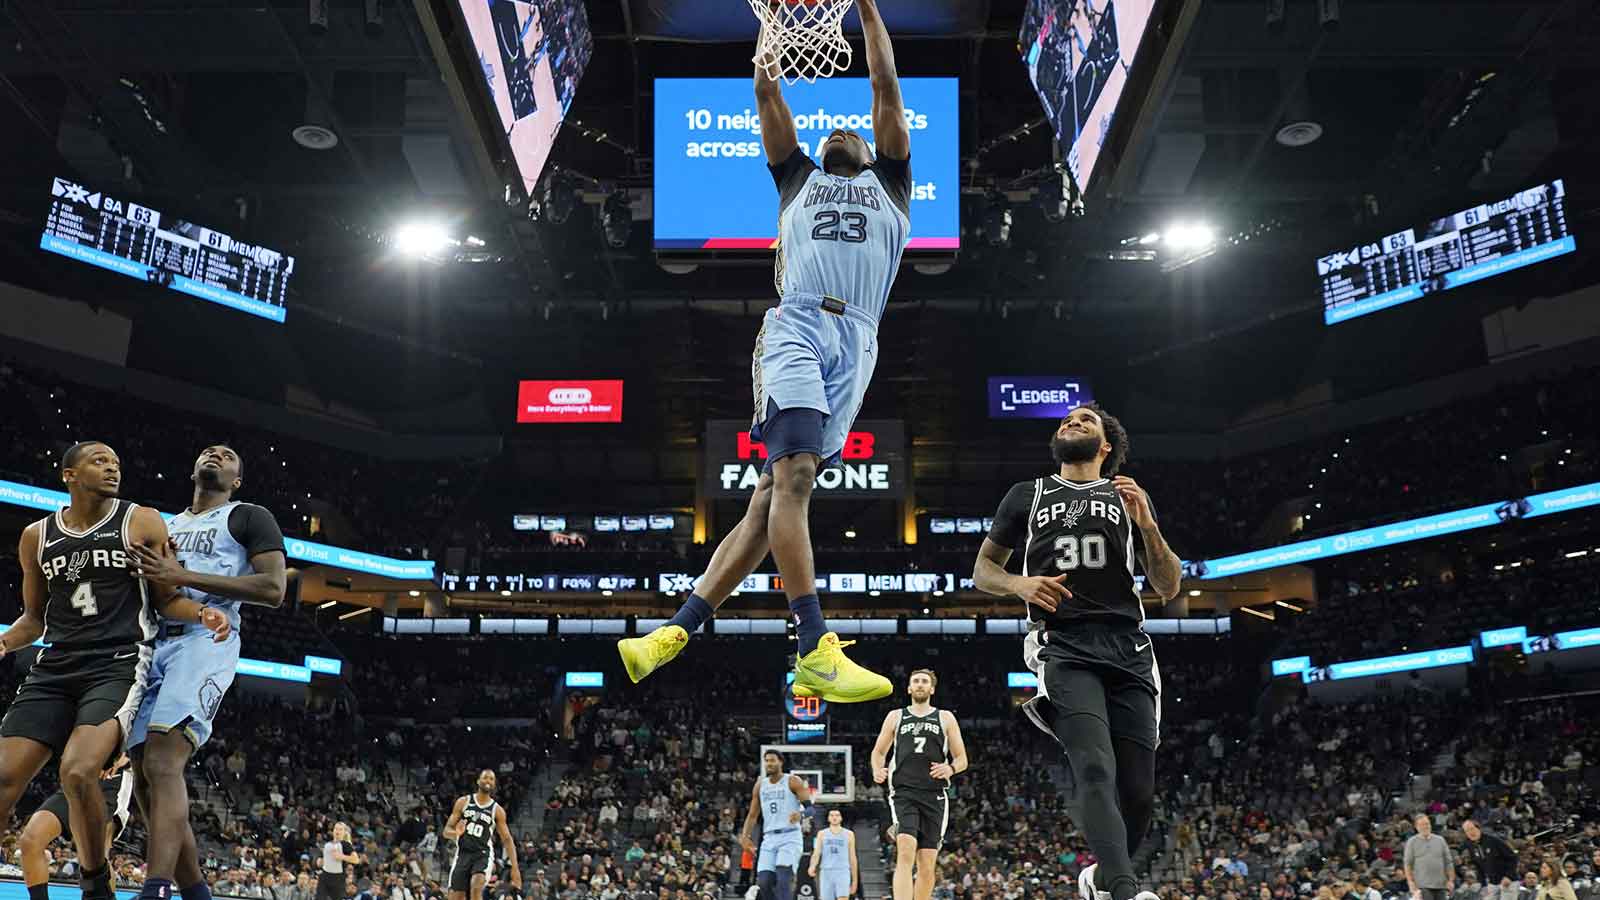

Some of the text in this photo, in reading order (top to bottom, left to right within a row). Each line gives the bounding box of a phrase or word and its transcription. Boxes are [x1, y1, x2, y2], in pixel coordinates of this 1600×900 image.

[685, 108, 712, 130] 10
[716, 108, 873, 135] neigorhood
[686, 141, 760, 158] across
[803, 182, 881, 212] GRIZZLIES
[103, 196, 152, 224] SA 63
[1464, 210, 1480, 225] 61
[1487, 196, 1517, 217] MEM
[811, 210, 868, 243] 23
[208, 231, 256, 259] 61 MEM
[1360, 242, 1381, 259] SA
[1390, 233, 1407, 249] 63
[1011, 390, 1070, 404] LEDGER
[720, 464, 889, 489] FA ONE
[1054, 534, 1107, 571] 30
[527, 578, 543, 588] TO
[619, 578, 635, 588] PF
[743, 577, 756, 589] 63
[841, 577, 852, 589] 61
[868, 575, 902, 590] MEM
[70, 581, 99, 617] 4
[792, 697, 820, 717] 20
[913, 737, 927, 753] 7
[769, 802, 778, 814] 8
[466, 822, 484, 838] 40
